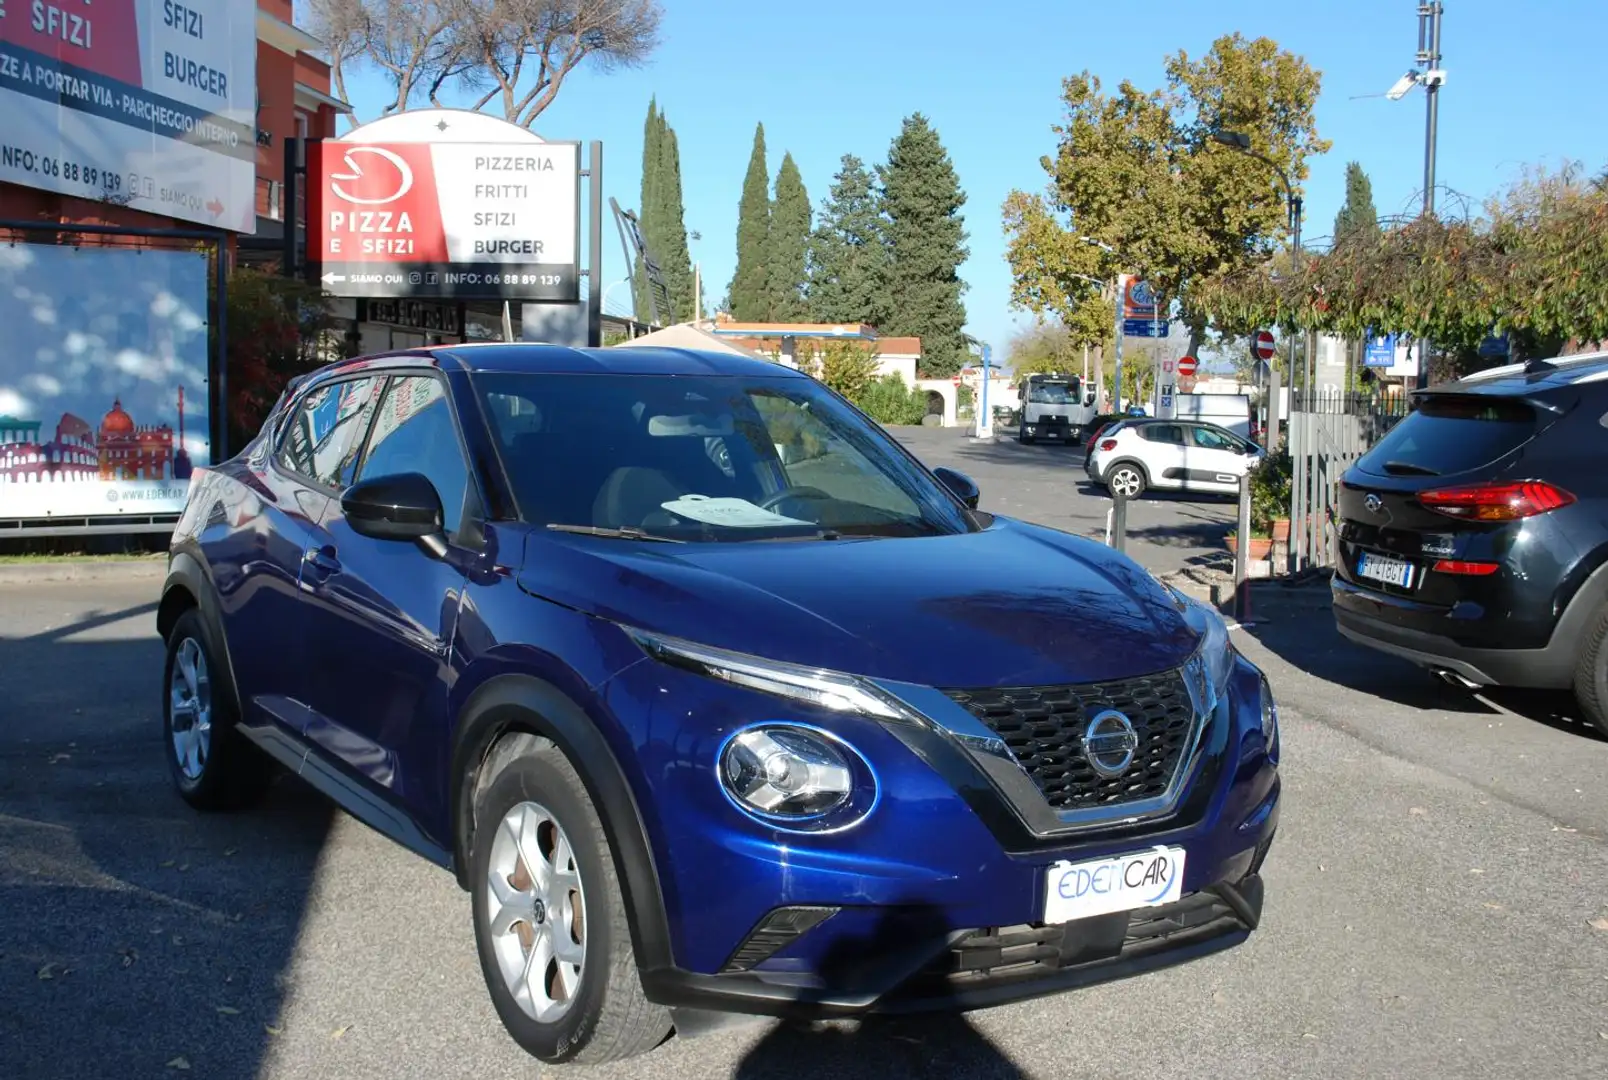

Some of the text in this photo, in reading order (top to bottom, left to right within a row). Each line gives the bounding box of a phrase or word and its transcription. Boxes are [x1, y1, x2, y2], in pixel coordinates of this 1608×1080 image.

[31, 0, 92, 49] SFIZI
[164, 0, 203, 40] SFIZI
[164, 50, 227, 99] BURGER
[22, 60, 33, 83] A
[36, 65, 90, 101] PORTAR
[91, 83, 113, 108] VIA
[122, 94, 193, 133] PARCHEGGIO
[195, 118, 239, 148] INTERNO
[42, 156, 59, 177] 06
[63, 161, 79, 182] 88
[83, 165, 98, 186] 89
[101, 170, 122, 190] 139
[474, 156, 555, 172] PIZZERIA
[160, 187, 187, 207] SIAMO
[474, 184, 528, 199] FRITTI
[329, 210, 414, 233] PIZZA
[473, 212, 516, 226] SFIZI
[329, 238, 415, 255] E SFIZI
[474, 239, 545, 255] BURGER
[350, 273, 404, 285] SIAMO QUI
[444, 272, 562, 286] INFO: 06 88 89 139
